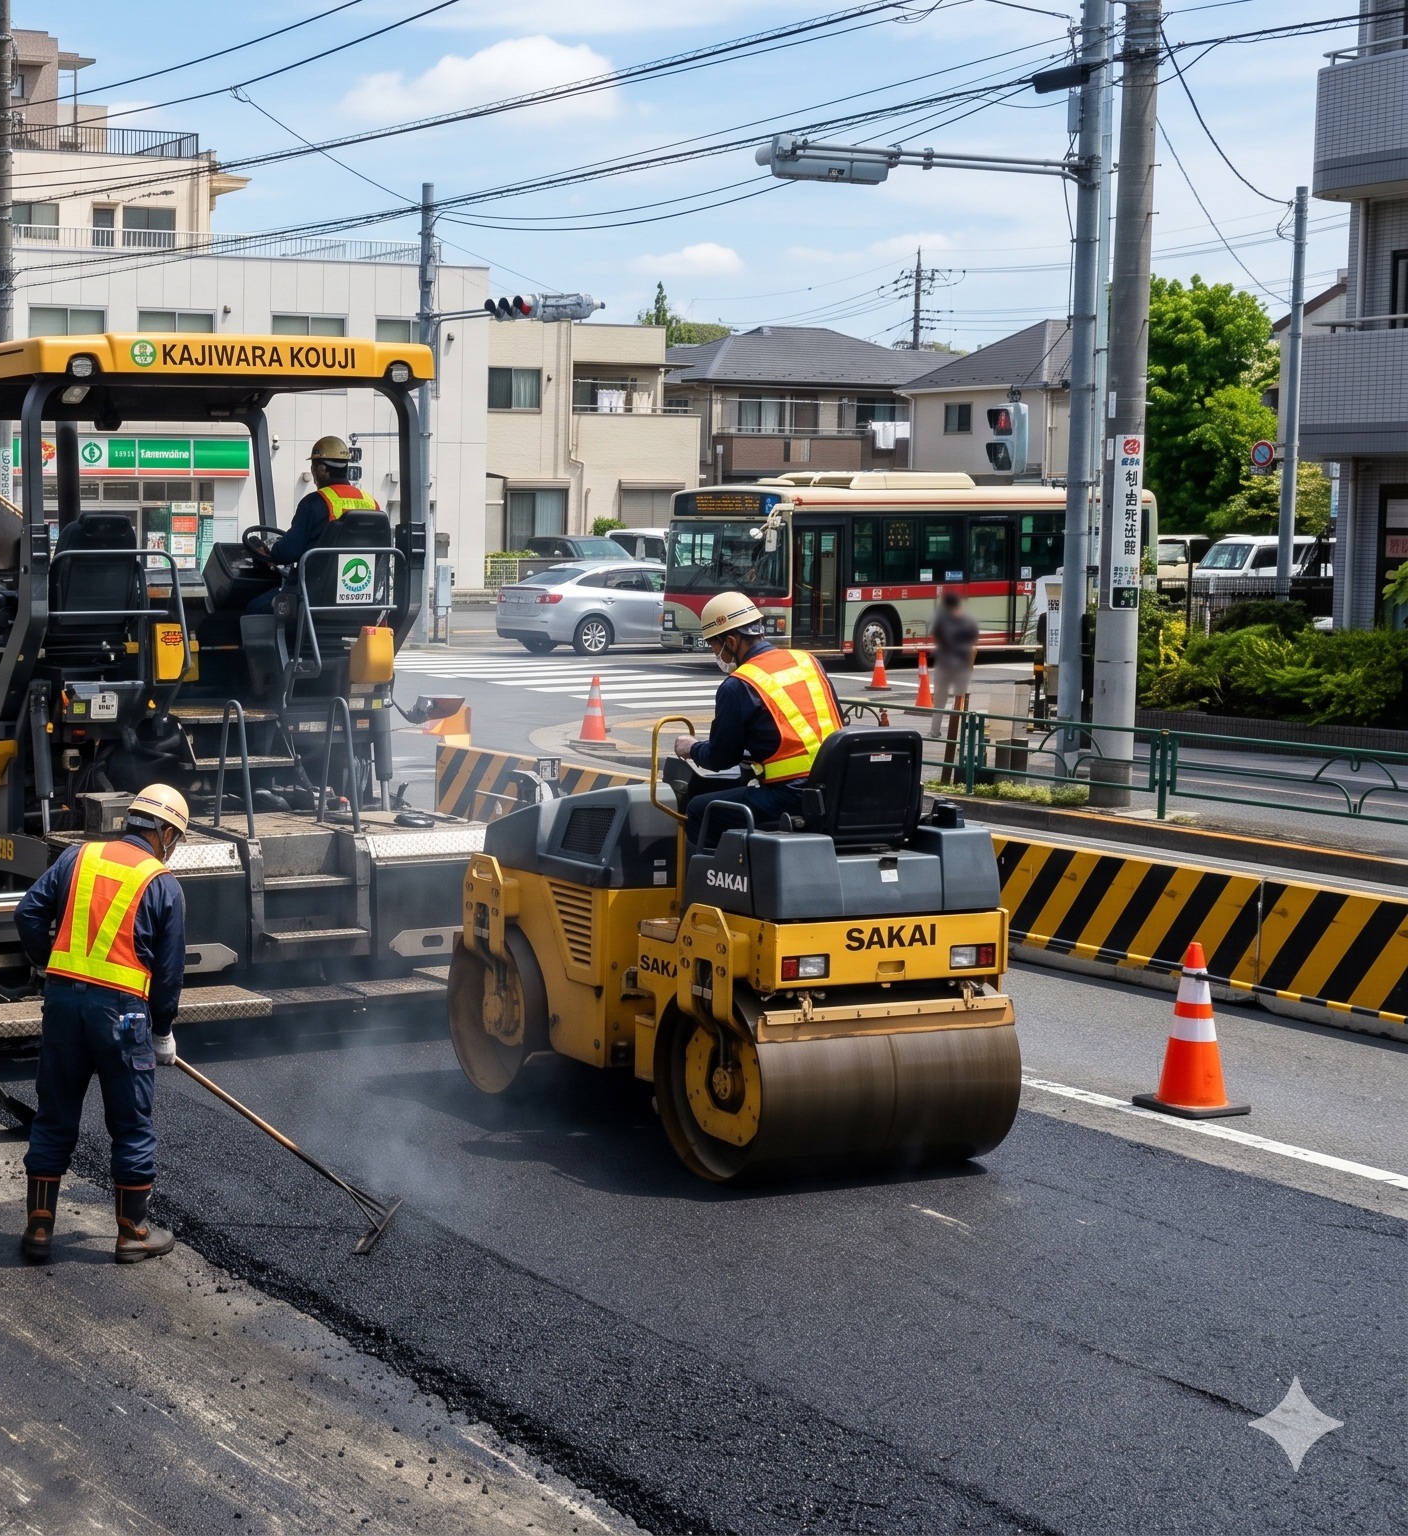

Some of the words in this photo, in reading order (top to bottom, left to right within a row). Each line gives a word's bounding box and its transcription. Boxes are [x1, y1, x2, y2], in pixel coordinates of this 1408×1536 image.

[162, 343, 284, 368] KAJIWARA
[290, 346, 356, 369] KOUJI
[706, 869, 748, 893] SAKAI
[845, 923, 937, 951] SAKAI
